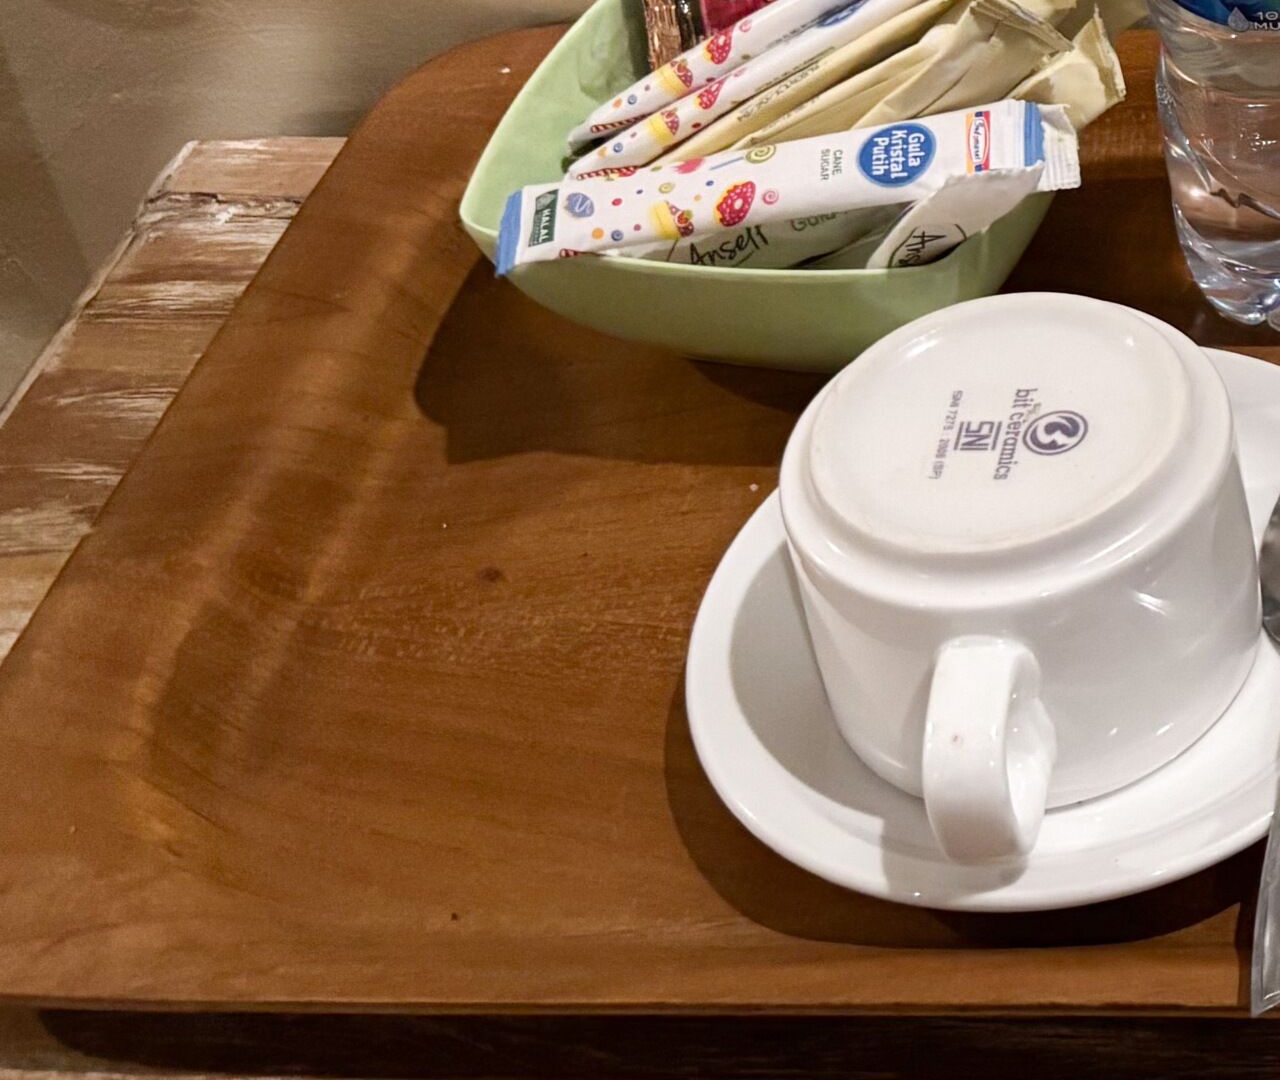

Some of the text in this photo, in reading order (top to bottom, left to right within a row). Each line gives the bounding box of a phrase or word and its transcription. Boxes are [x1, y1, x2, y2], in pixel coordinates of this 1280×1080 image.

[820, 148, 831, 182] SUGAR
[832, 149, 844, 176] CANE
[871, 136, 890, 177] Putih
[890, 129, 909, 180] Kristal
[907, 132, 925, 169] Gula
[540, 208, 552, 243] HALAL
[960, 421, 995, 451] SNI
[993, 388, 1038, 480] bit ceramics
